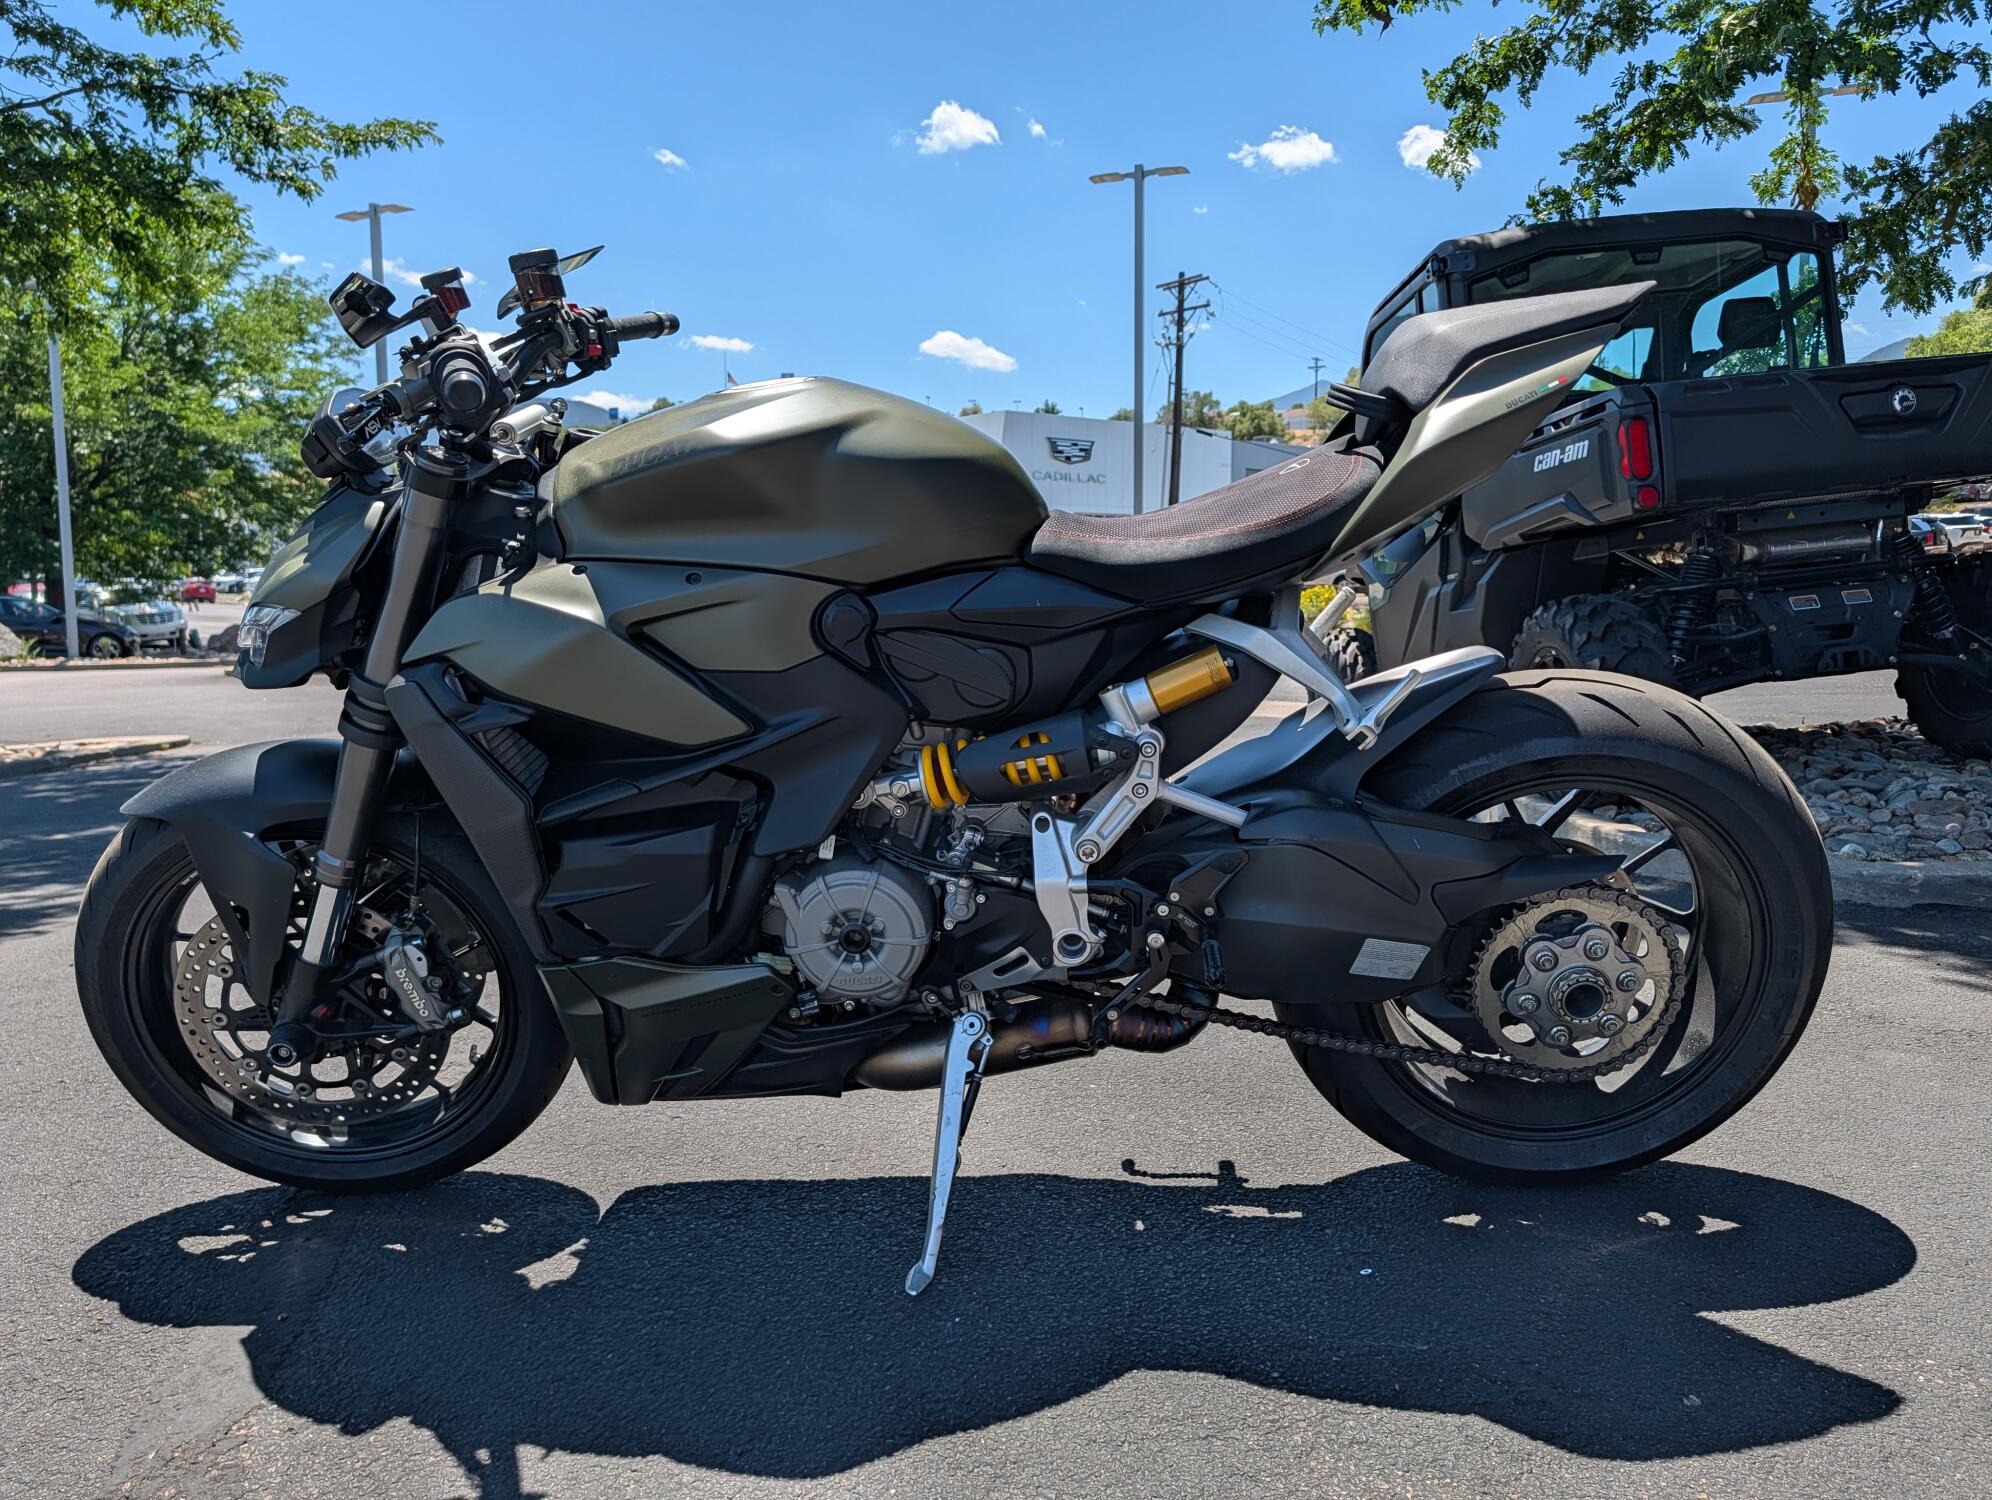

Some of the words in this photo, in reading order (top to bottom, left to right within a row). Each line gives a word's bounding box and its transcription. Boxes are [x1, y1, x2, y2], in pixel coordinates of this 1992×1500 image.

[1505, 391, 1538, 409] DUCATI
[1533, 439, 1590, 473] can-am
[1031, 470, 1107, 485] CADILLAC
[395, 967, 429, 1017] brembo
